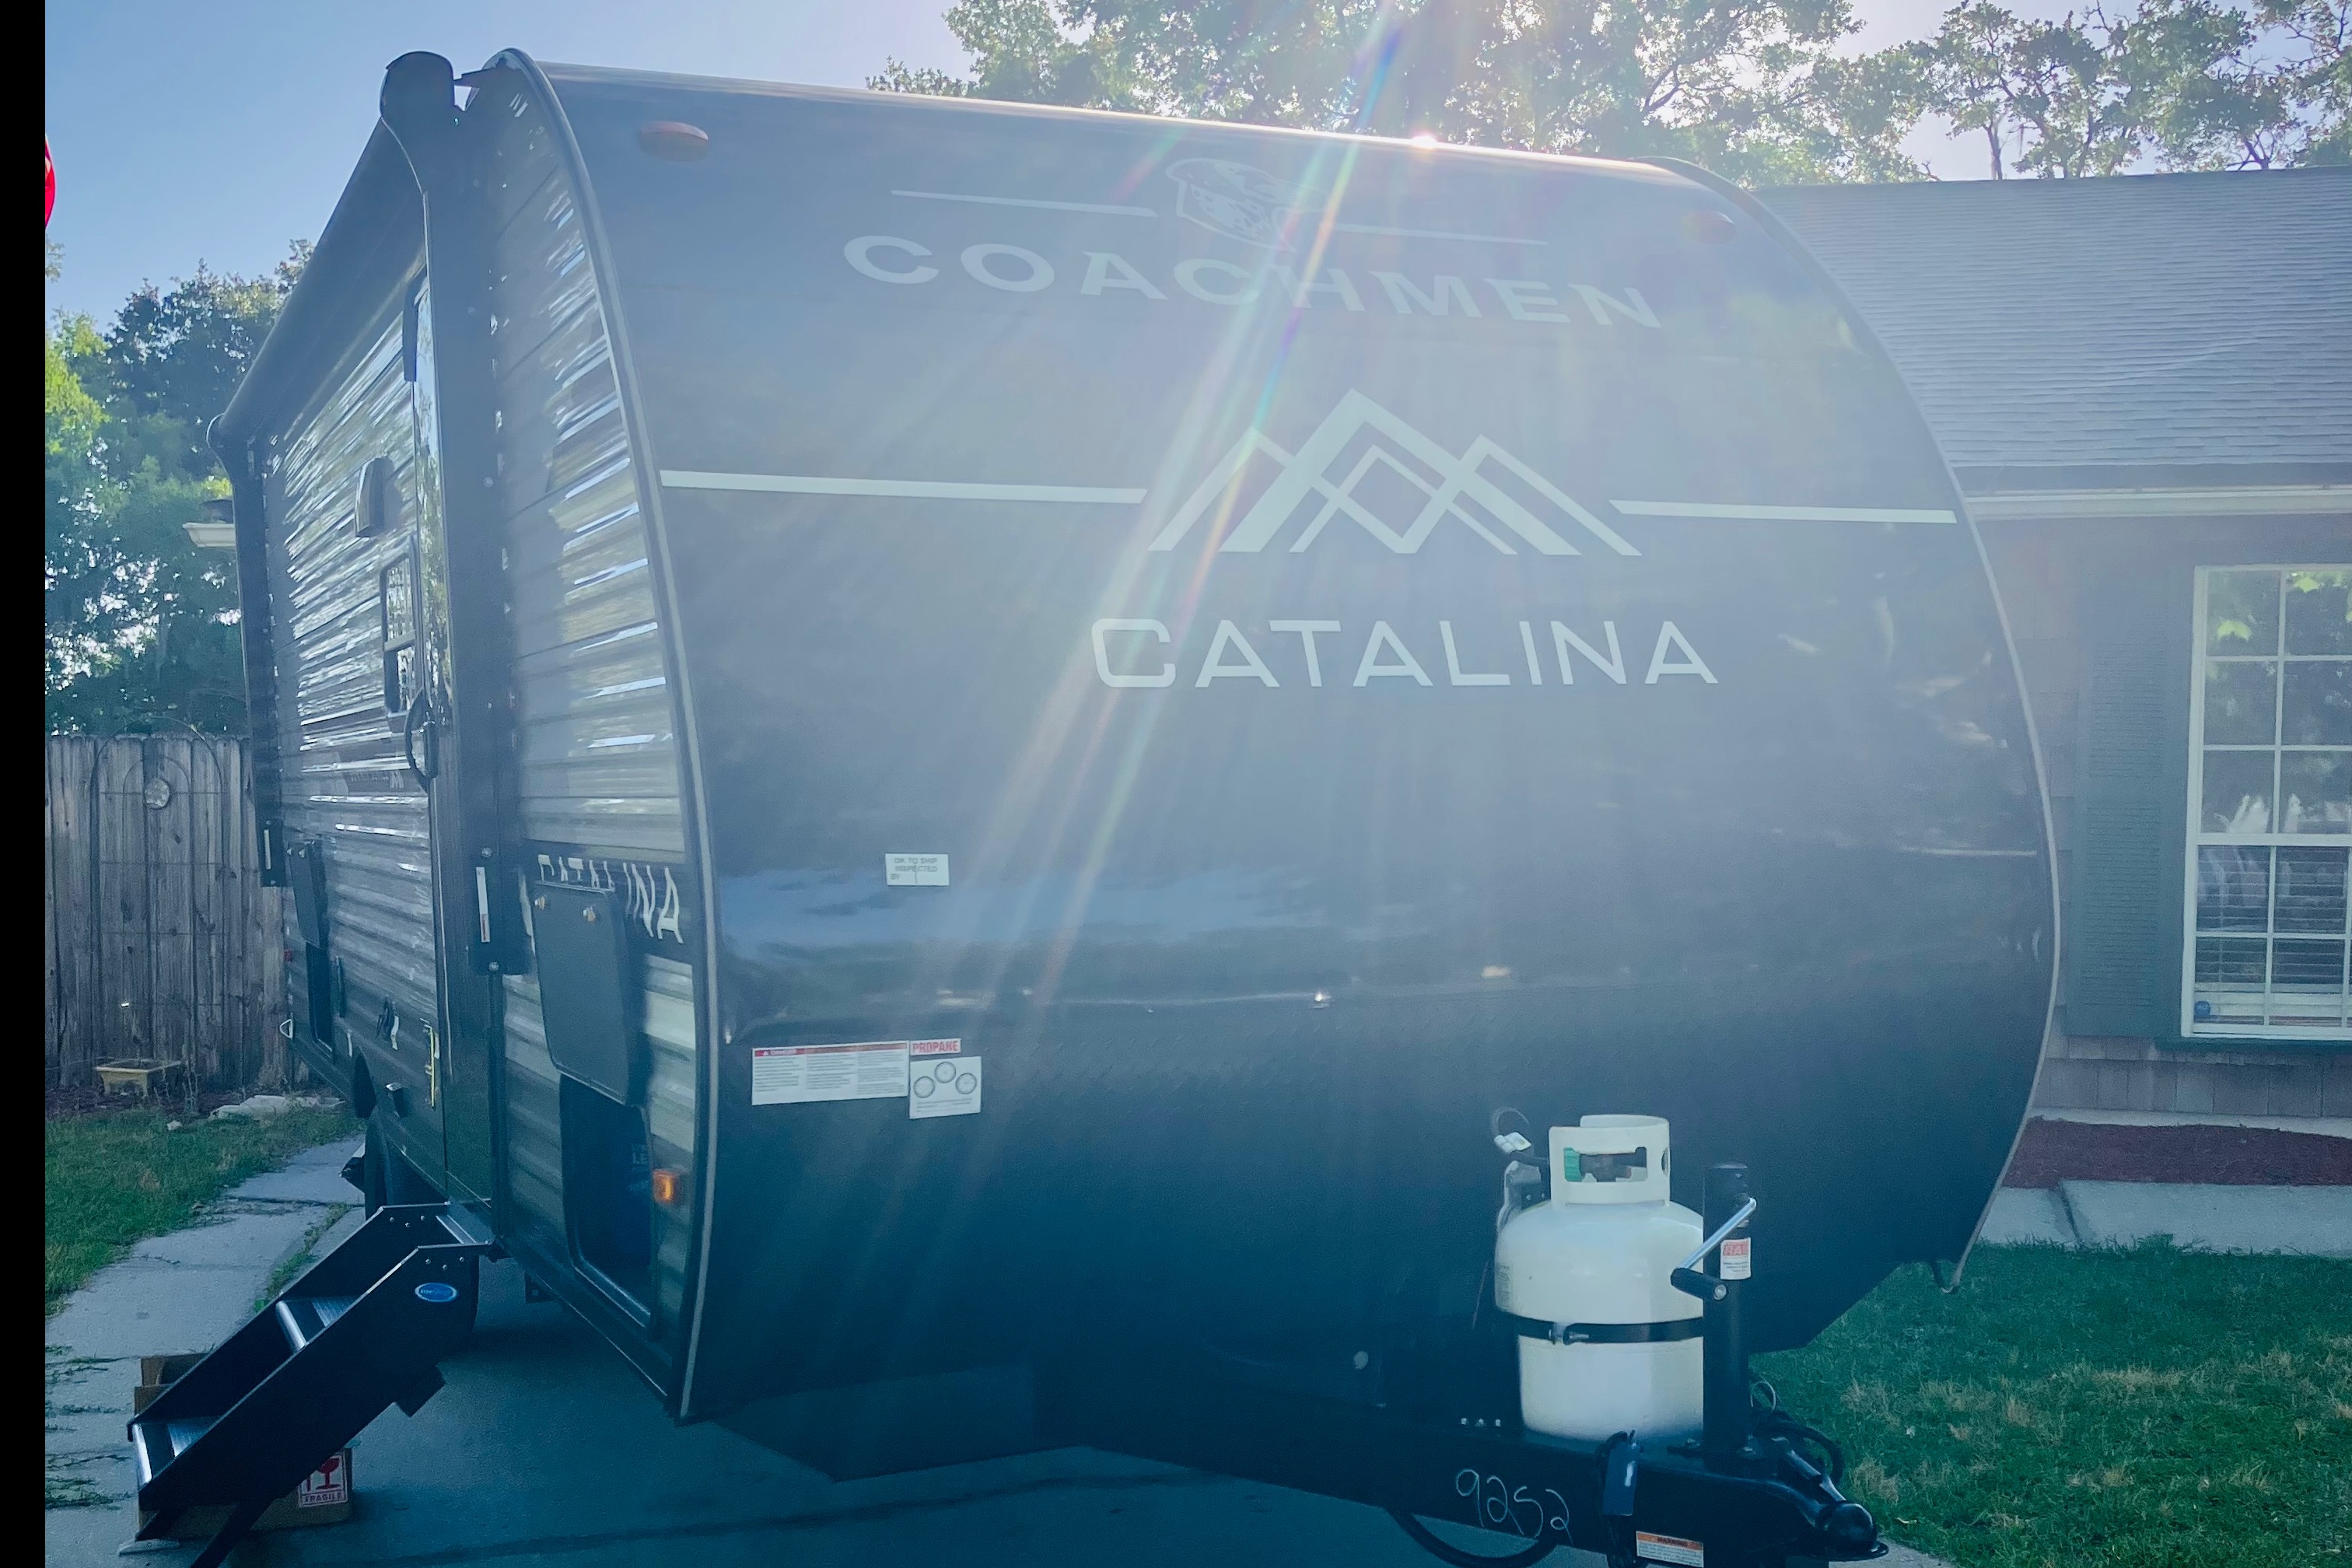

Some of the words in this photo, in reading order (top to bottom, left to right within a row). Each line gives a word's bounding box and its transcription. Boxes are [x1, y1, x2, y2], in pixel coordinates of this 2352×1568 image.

[843, 235, 1663, 329] COACHMEN
[1091, 618, 1719, 688] CATALINA
[912, 1040, 958, 1053] PROPANE
[304, 1490, 344, 1503] FRAGILE
[1456, 1468, 1574, 1546] 9252
